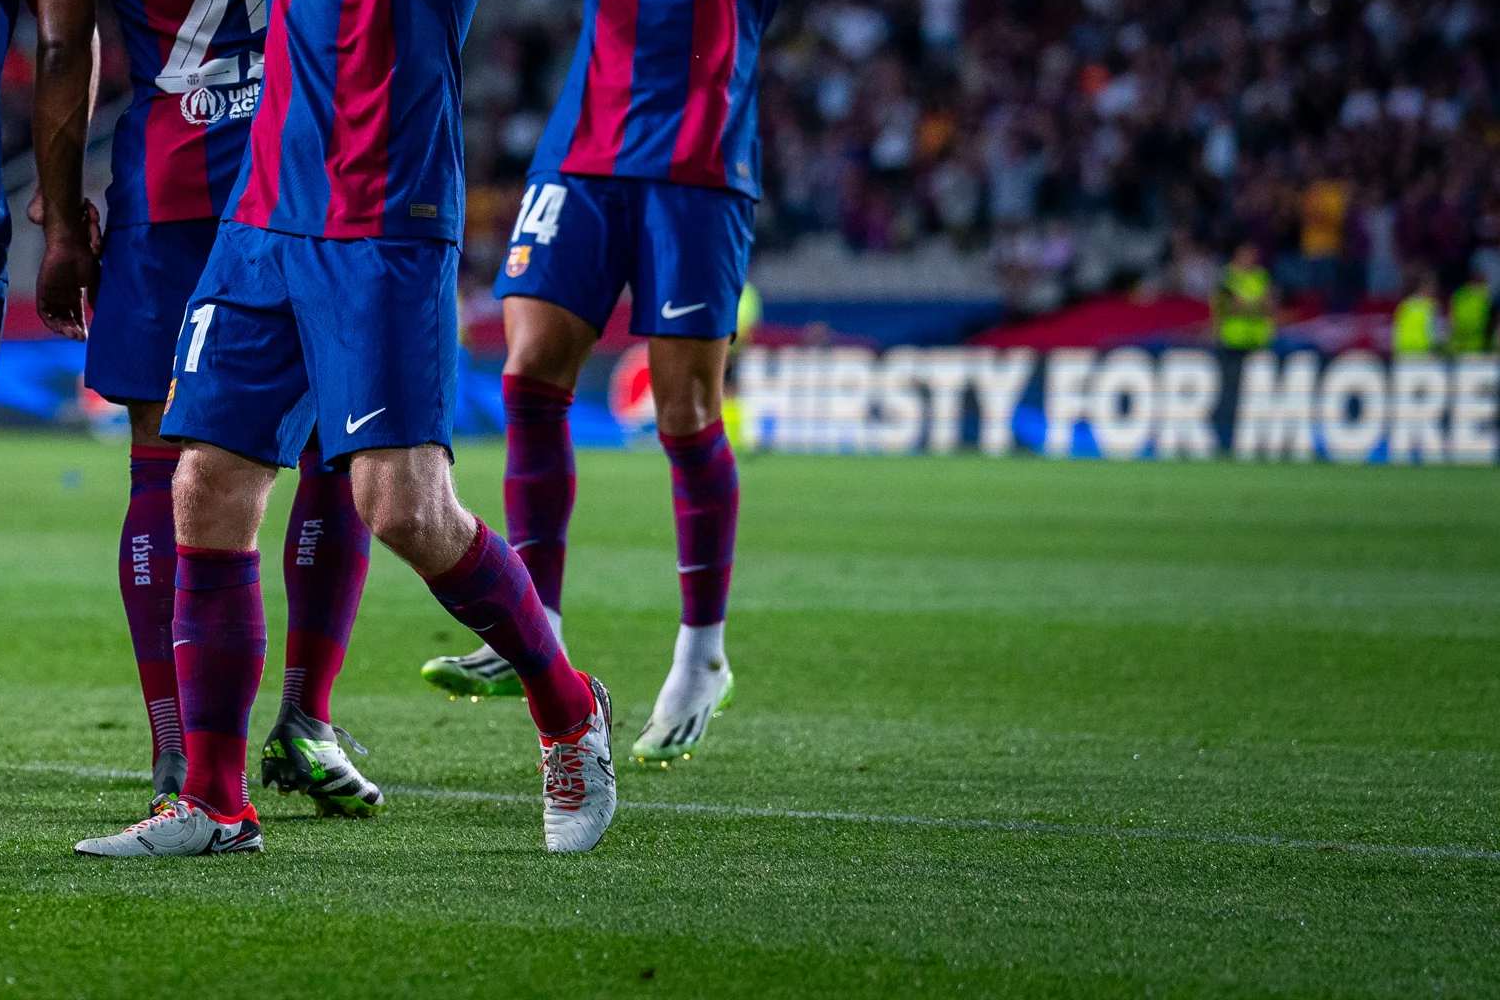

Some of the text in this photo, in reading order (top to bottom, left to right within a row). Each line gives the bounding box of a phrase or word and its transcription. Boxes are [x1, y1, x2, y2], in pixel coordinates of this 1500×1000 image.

[511, 183, 568, 245] 14
[173, 302, 216, 373] 1
[1043, 346, 1222, 460] FOR
[1232, 348, 1500, 465] MORE
[132, 533, 153, 586] BARÇA
[296, 518, 324, 566] BARÇA
